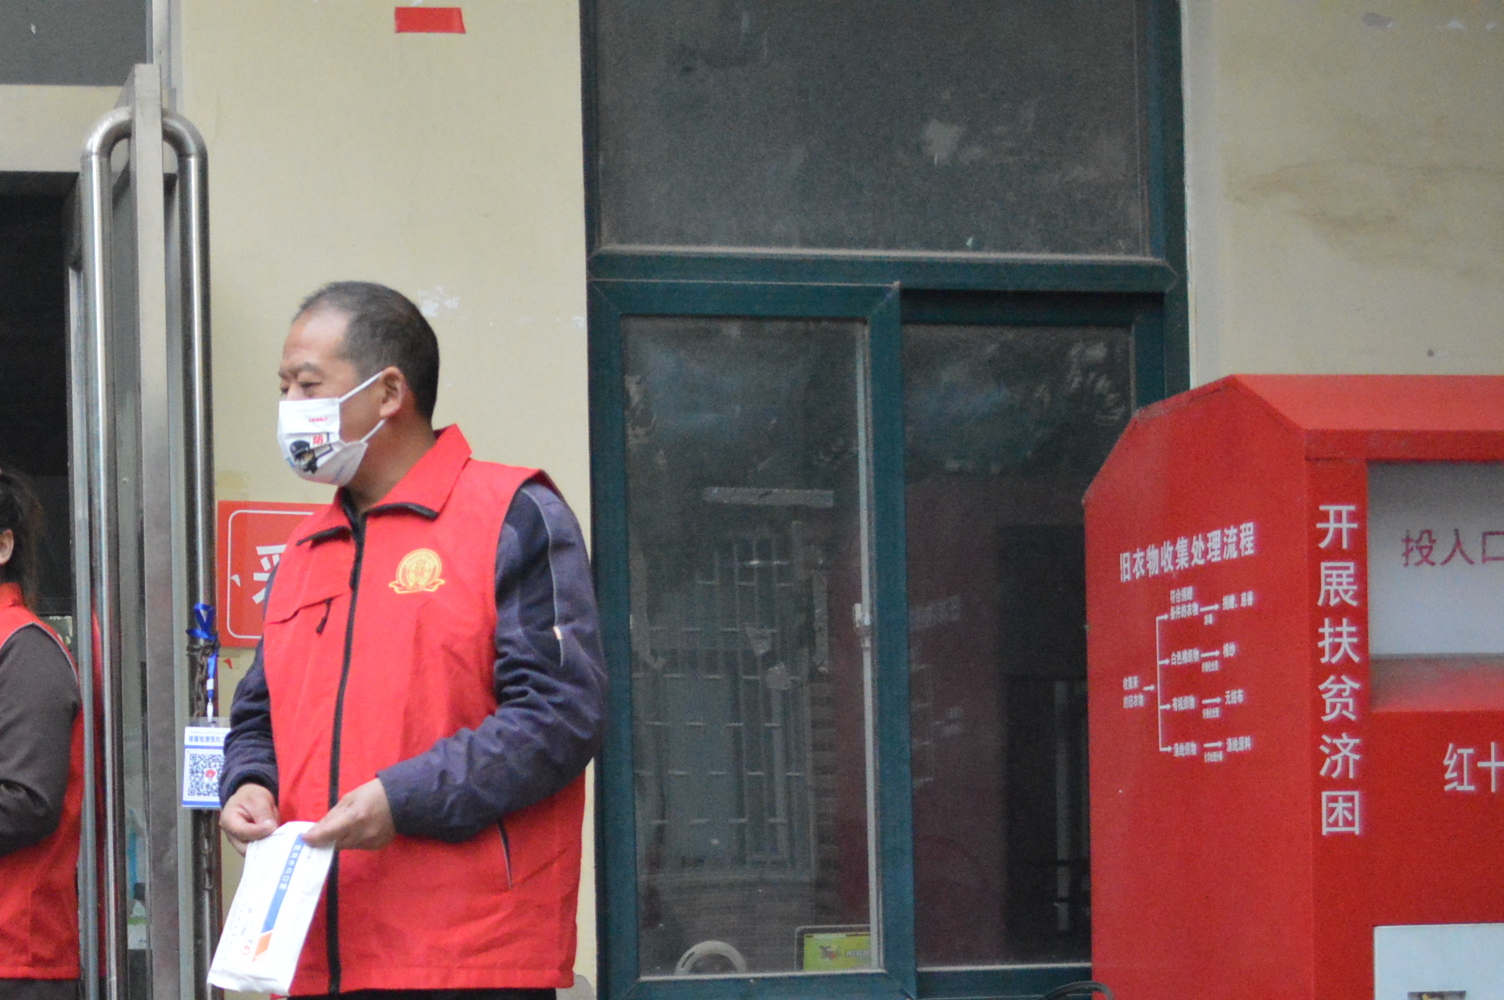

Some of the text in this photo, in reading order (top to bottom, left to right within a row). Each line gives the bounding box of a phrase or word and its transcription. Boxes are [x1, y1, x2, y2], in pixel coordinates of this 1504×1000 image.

[1119, 521, 1255, 583] 旧衣物收集处理流程
[1401, 528, 1504, 568] 投入口
[1316, 504, 1361, 836] 开展扶贫济困
[1443, 741, 1504, 792] 红十
